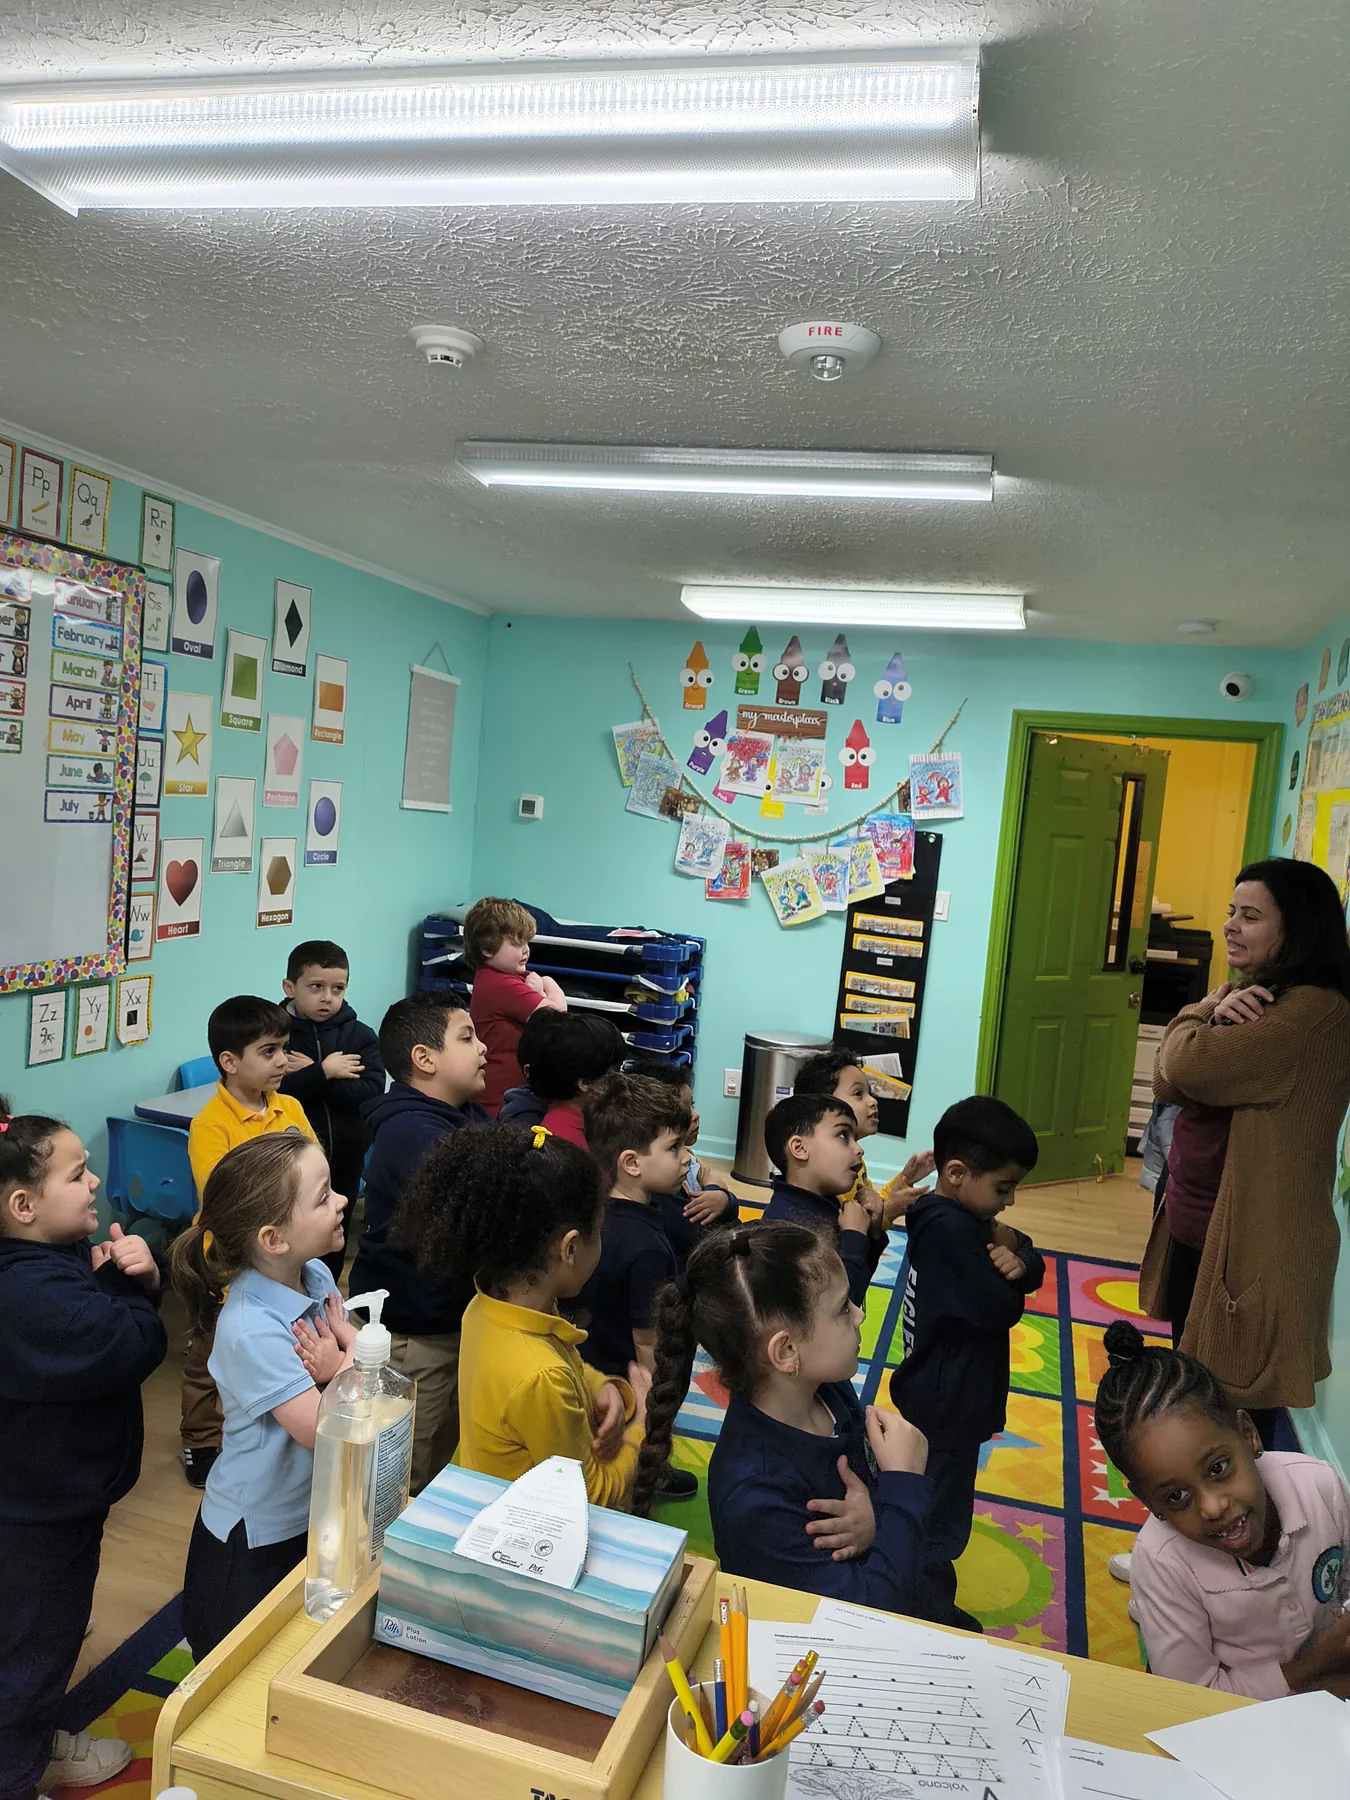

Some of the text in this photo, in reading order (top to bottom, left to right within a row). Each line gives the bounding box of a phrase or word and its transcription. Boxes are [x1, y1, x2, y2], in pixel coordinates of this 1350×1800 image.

[808, 326, 843, 336] FIRE
[32, 466, 51, 498] Pp
[77, 483, 101, 517] Qq
[150, 508, 167, 529] Rr
[65, 592, 102, 614] anuary
[57, 626, 105, 649] February
[183, 641, 202, 653] Oval
[62, 661, 97, 679] March
[273, 661, 303, 674] Diamond
[65, 694, 92, 710] April
[228, 715, 254, 727] Square
[738, 711, 759, 728] my
[62, 729, 86, 746] May
[314, 728, 342, 741] Rectangle
[59, 764, 83, 777] June
[688, 761, 706, 775] Purple
[178, 780, 194, 792] Star
[266, 793, 297, 803] Pentagon
[59, 799, 80, 814] July
[312, 852, 330, 861] Circle
[218, 859, 246, 870] Triangle
[261, 912, 289, 923] Hexagon
[168, 925, 189, 936] Heart
[126, 988, 142, 1006] Xx
[39, 1003, 57, 1023] Zz
[86, 995, 102, 1021] Yy
[528, 1563, 545, 1573] P&G
[384, 1618, 400, 1634] Puffs
[406, 1626, 420, 1635] Plus
[406, 1633, 427, 1644] Lotion
[918, 1780, 969, 1792] Volcano
